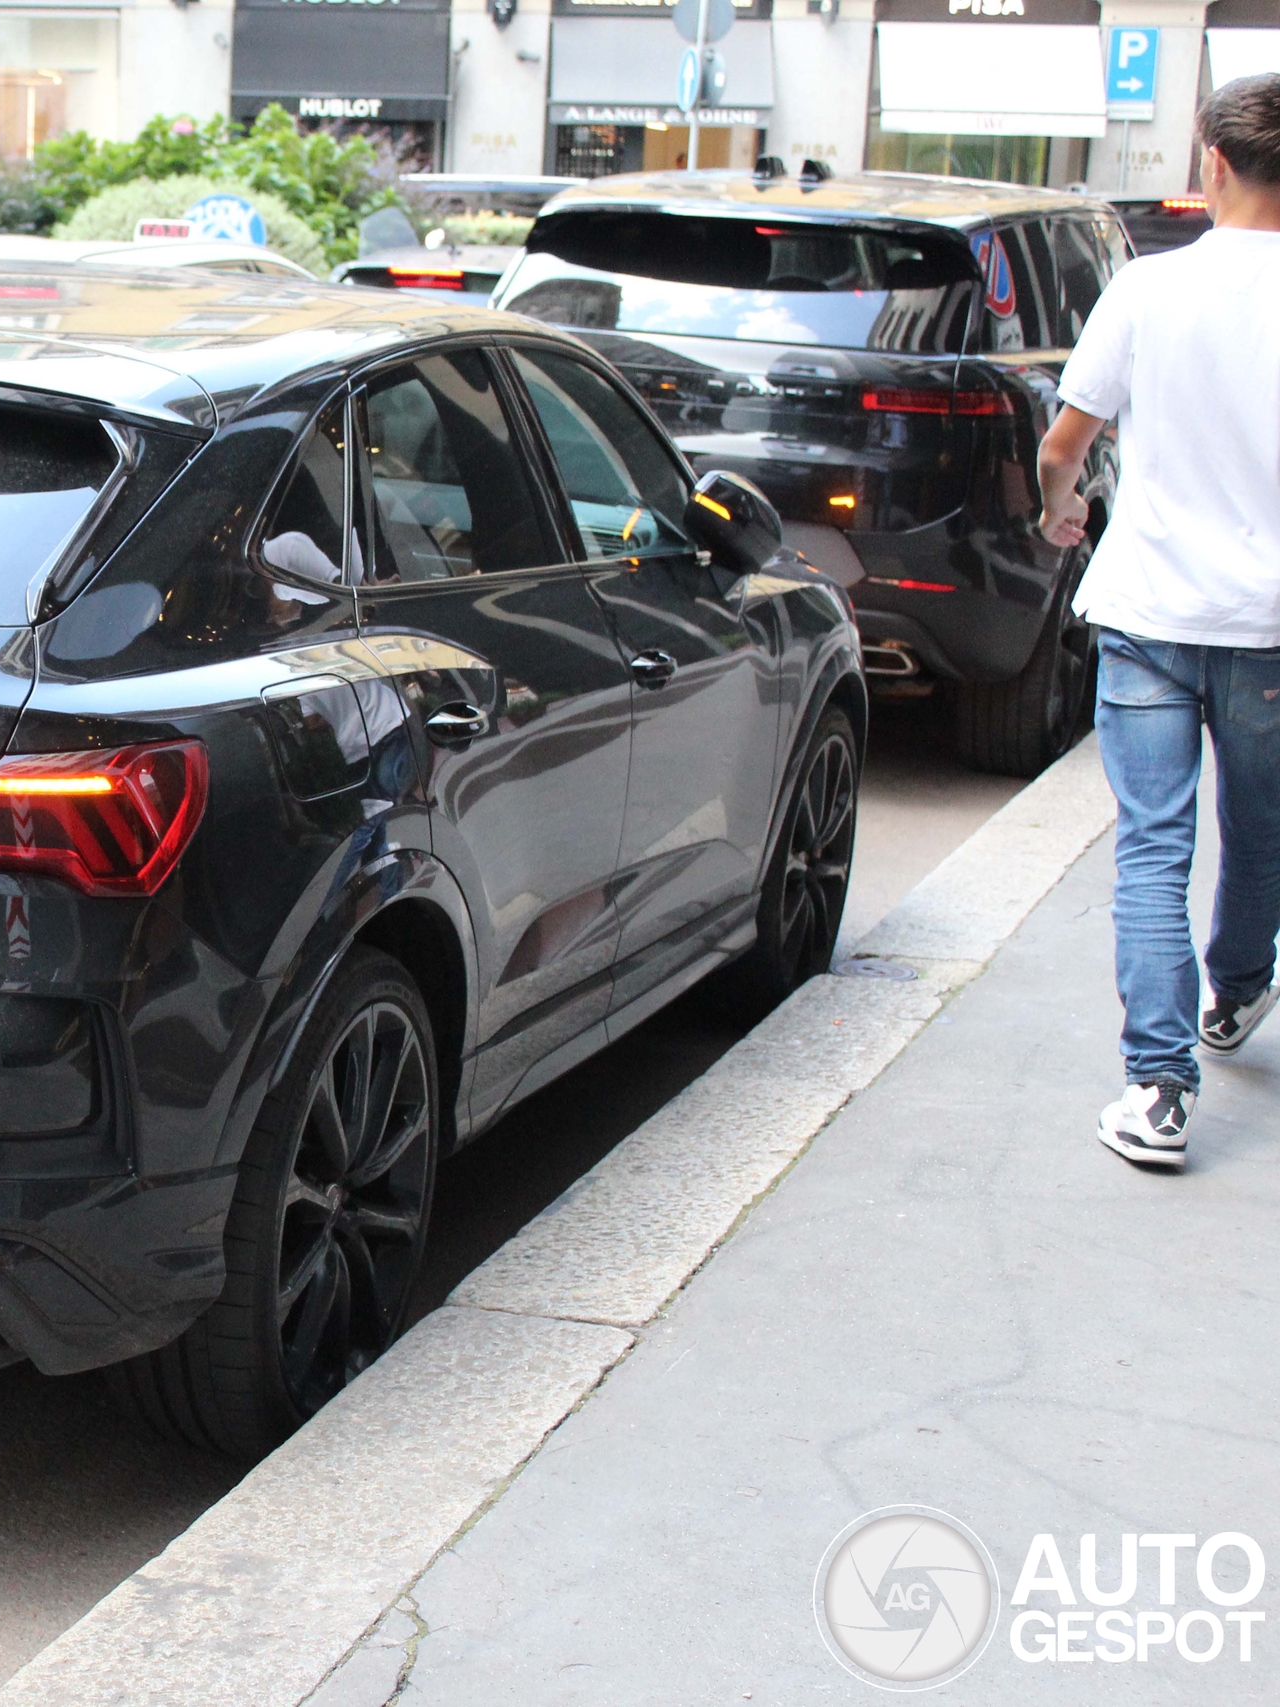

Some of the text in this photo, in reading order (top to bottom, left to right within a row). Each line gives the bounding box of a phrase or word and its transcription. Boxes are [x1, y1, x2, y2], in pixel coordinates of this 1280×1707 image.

[1118, 32, 1149, 69] P
[299, 97, 383, 118] HUBLOT
[586, 106, 658, 122] LANGE
[140, 223, 189, 238] TAXI
